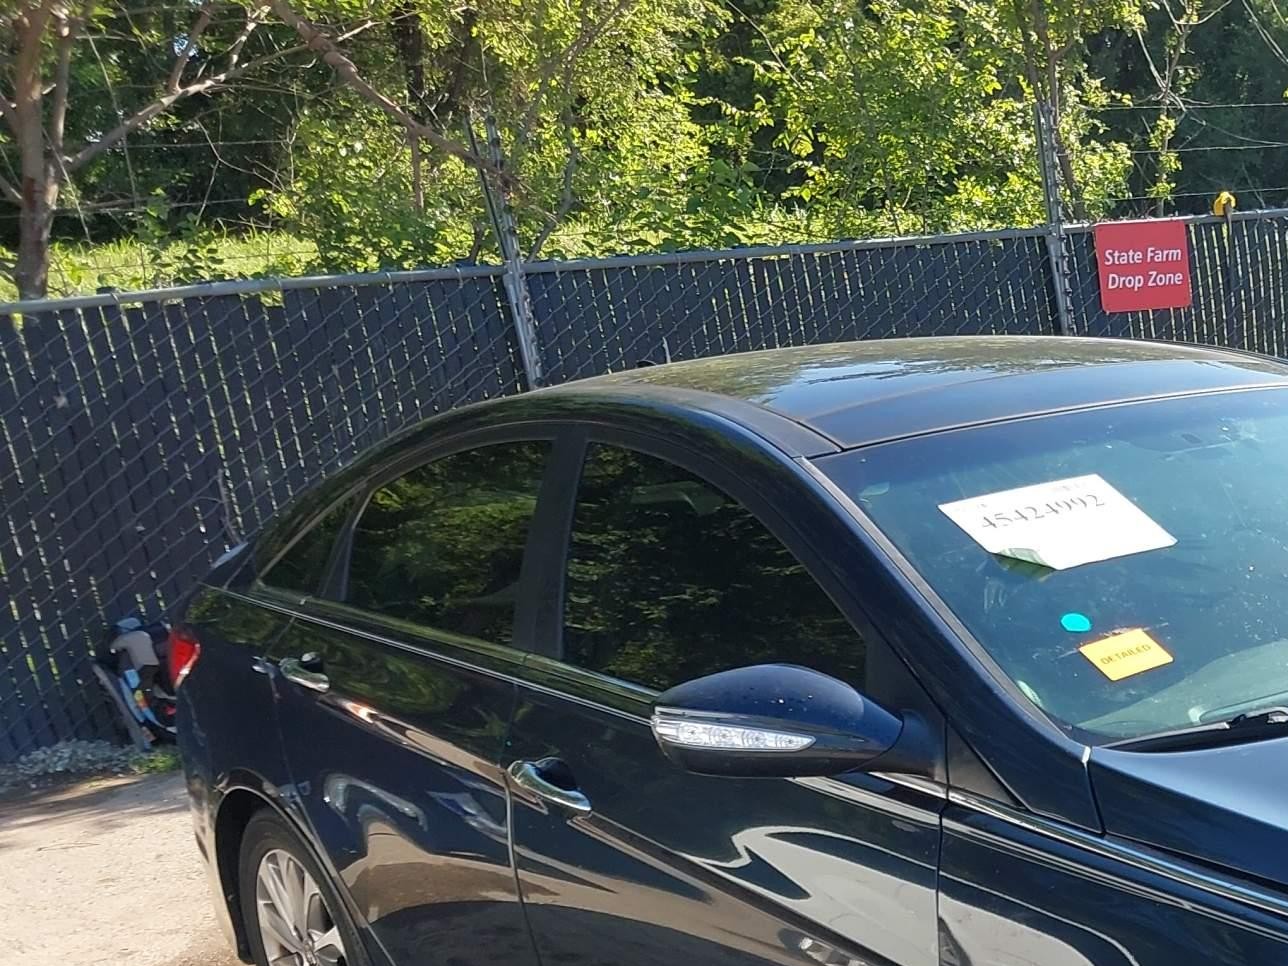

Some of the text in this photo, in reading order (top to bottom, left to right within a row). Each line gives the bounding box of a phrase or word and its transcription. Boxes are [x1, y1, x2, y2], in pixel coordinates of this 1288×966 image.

[1104, 247, 1182, 266] State Farm
[1107, 270, 1183, 292] Drop Zone
